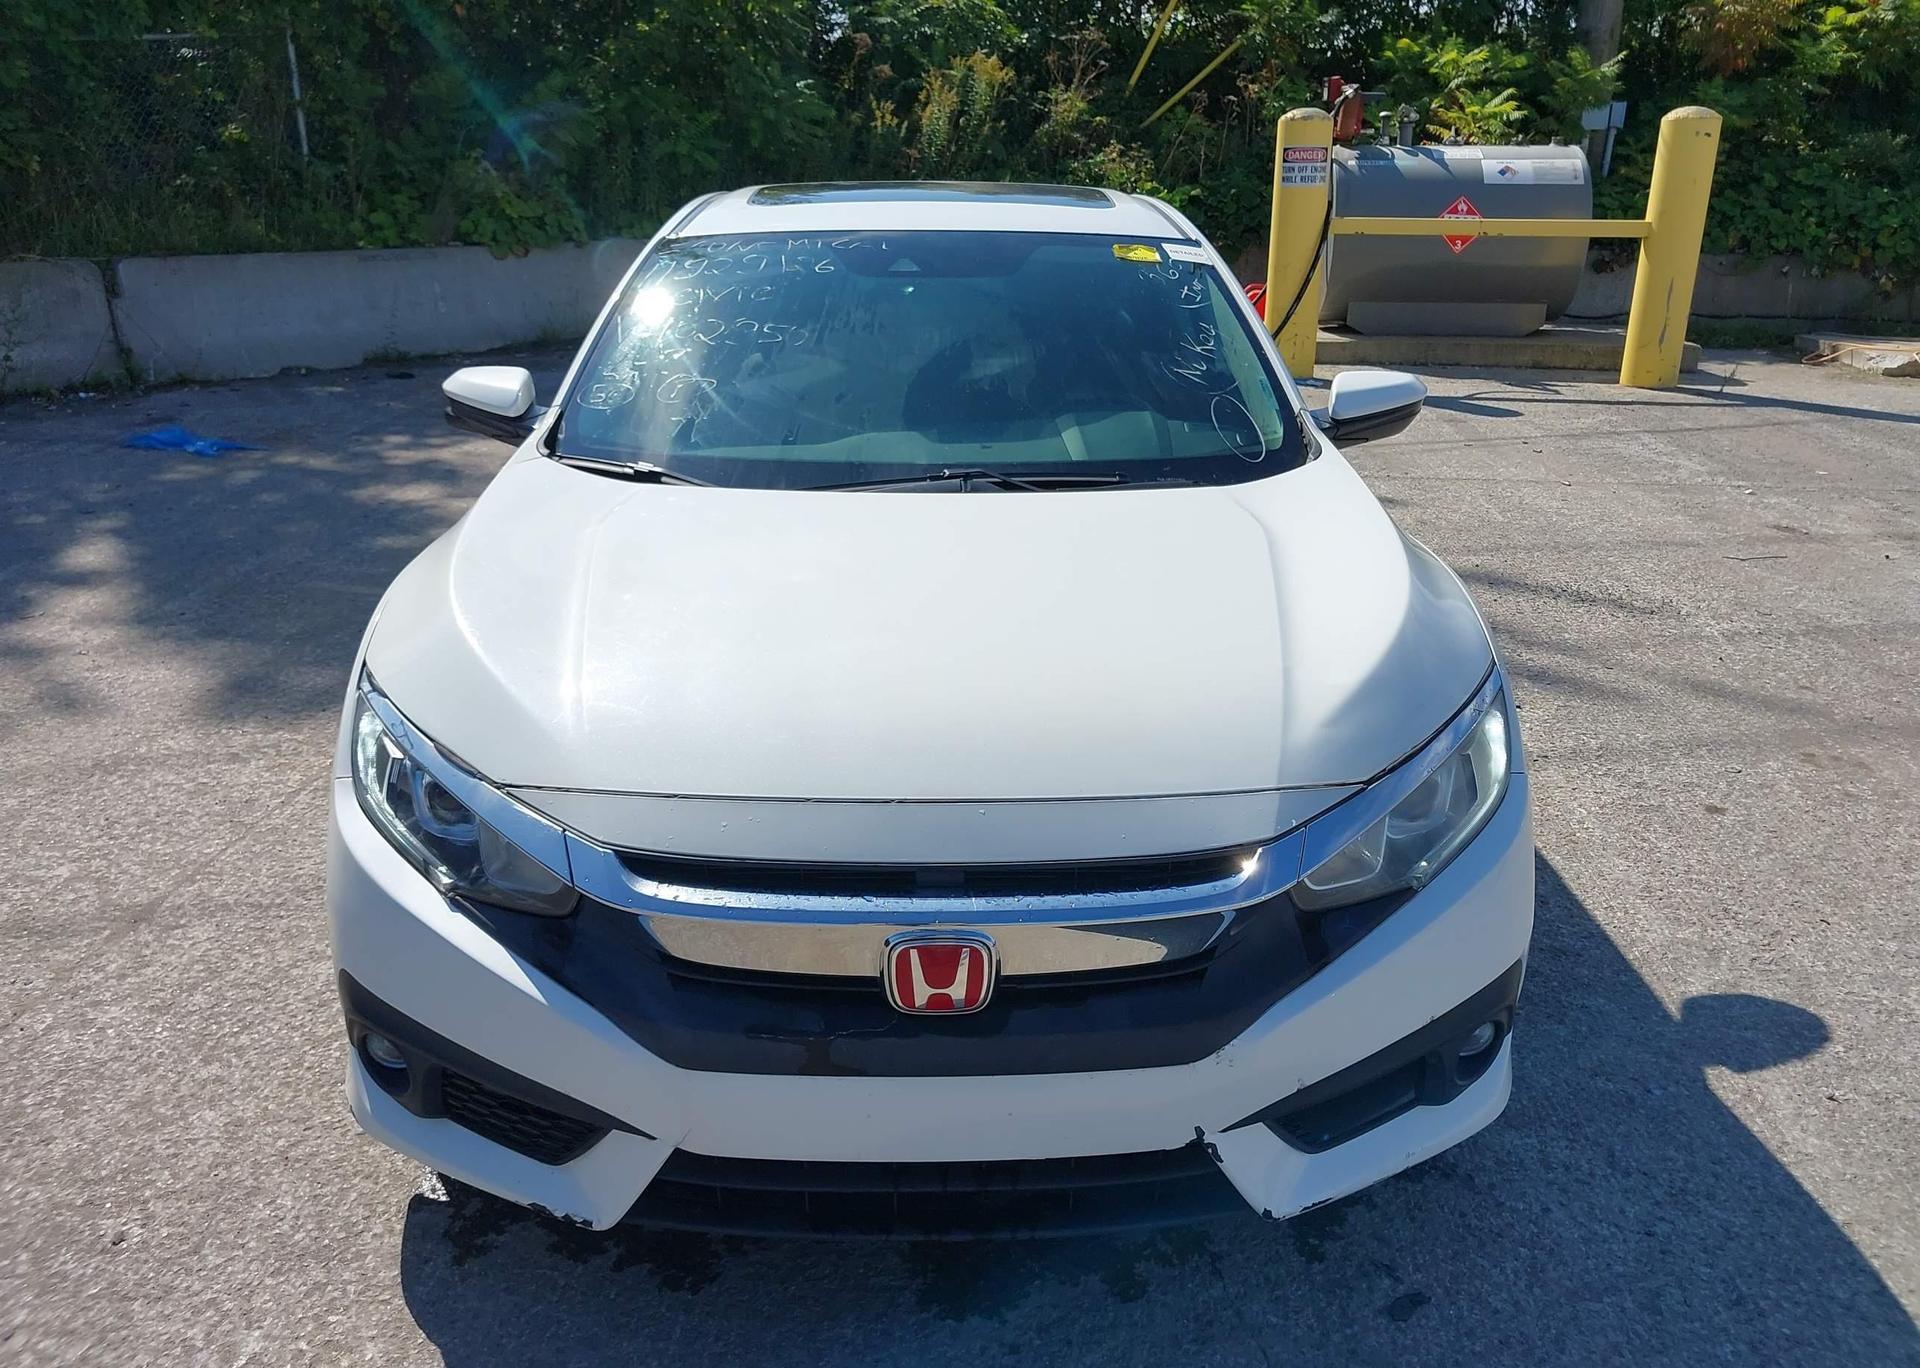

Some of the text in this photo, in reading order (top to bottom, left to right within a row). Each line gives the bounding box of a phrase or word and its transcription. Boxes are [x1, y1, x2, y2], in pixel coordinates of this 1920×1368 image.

[1288, 150, 1325, 160] DANGER
[1282, 165, 1296, 174] TURN
[1298, 165, 1308, 174] OFF
[1454, 240, 1462, 250] 3
[909, 947, 970, 1009] H
